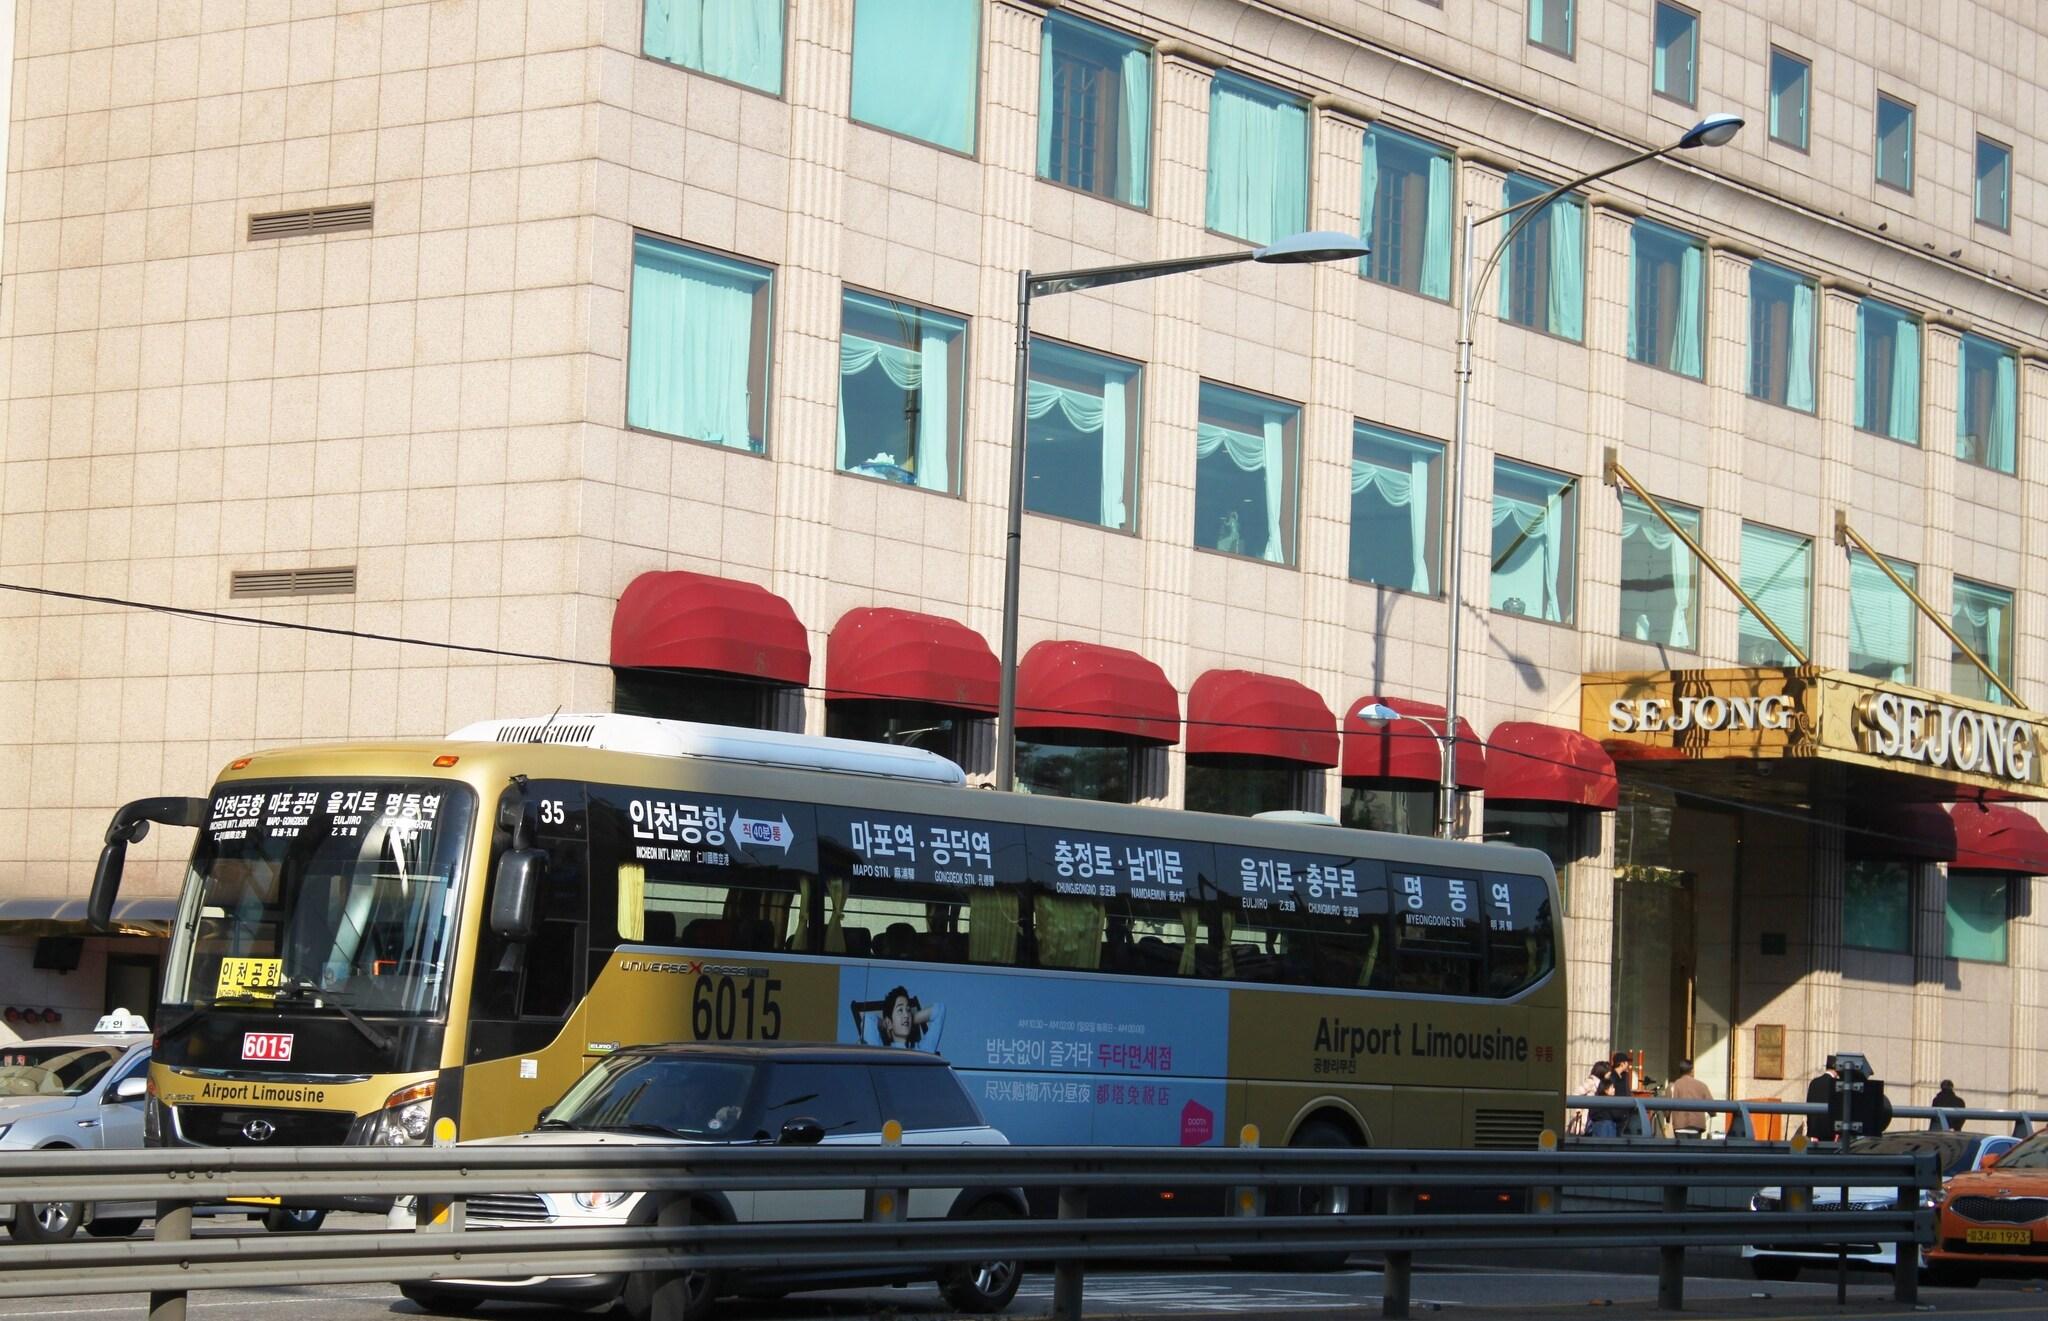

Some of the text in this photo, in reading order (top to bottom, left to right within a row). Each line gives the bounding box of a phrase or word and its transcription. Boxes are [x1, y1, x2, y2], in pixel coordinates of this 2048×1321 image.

[1608, 695, 1794, 732] SEJONG
[1871, 692, 2033, 782] SEJONG
[213, 794, 265, 819] 인천공항
[326, 791, 377, 813] 을지로
[384, 792, 440, 818] 명동역
[540, 799, 565, 824] 35
[333, 815, 361, 825] EULJIRO
[629, 800, 726, 846] 인천공항
[636, 846, 658, 859] INCHEON
[671, 849, 691, 862] AIRPORT
[853, 864, 891, 878] MAPO STN.
[935, 871, 964, 884] GONGDEOK
[1131, 887, 1167, 900] NAMDAEMUN
[1242, 897, 1268, 909] EULJIRO
[1406, 914, 1450, 926] MYEONGDONG
[221, 962, 278, 987] 인천공항
[692, 975, 782, 1040] 6015
[244, 1036, 291, 1057] 6015
[1314, 1017, 1528, 1062] Airport Limousine
[986, 1039, 1172, 1071] 밤낮없이 즐겨라 두타면세점
[1313, 1057, 1357, 1074] 공항리무진
[202, 1083, 248, 1101] Airport
[252, 1085, 325, 1103] Limousine
[985, 1080, 1091, 1103] 尽兴购物不分昼夜
[2000, 1231, 2027, 1243] 1993
